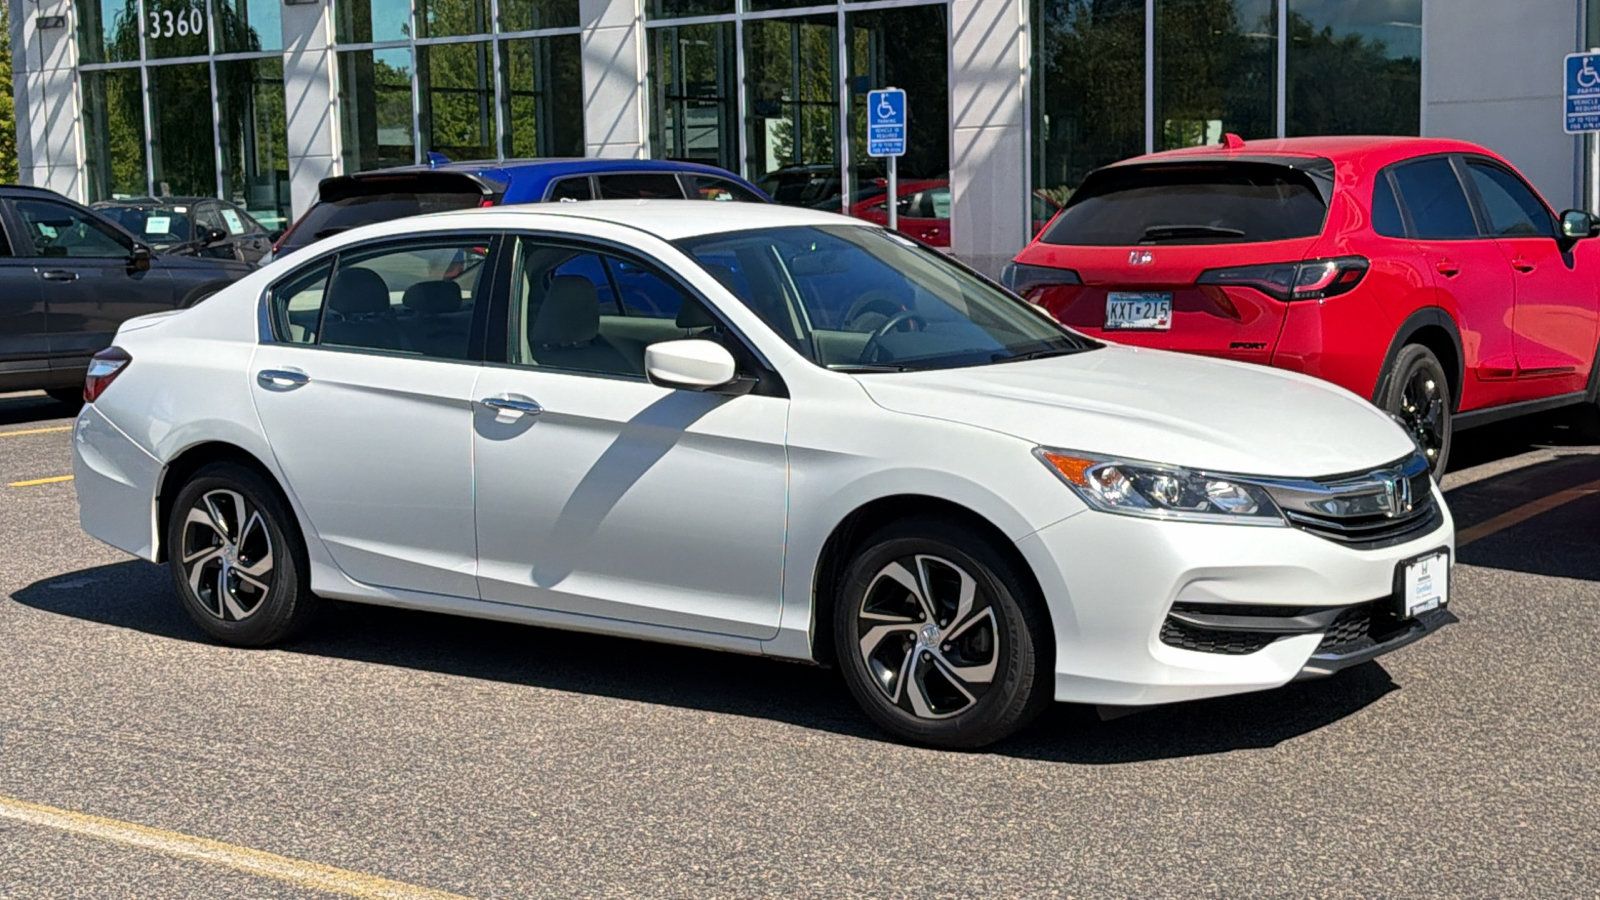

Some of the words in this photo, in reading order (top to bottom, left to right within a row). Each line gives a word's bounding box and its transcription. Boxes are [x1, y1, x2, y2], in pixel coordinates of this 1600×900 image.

[150, 8, 203, 38] 3360
[1110, 302, 1135, 320] KXT
[1143, 302, 1168, 319] 215
[1230, 342, 1268, 350] SPORT
